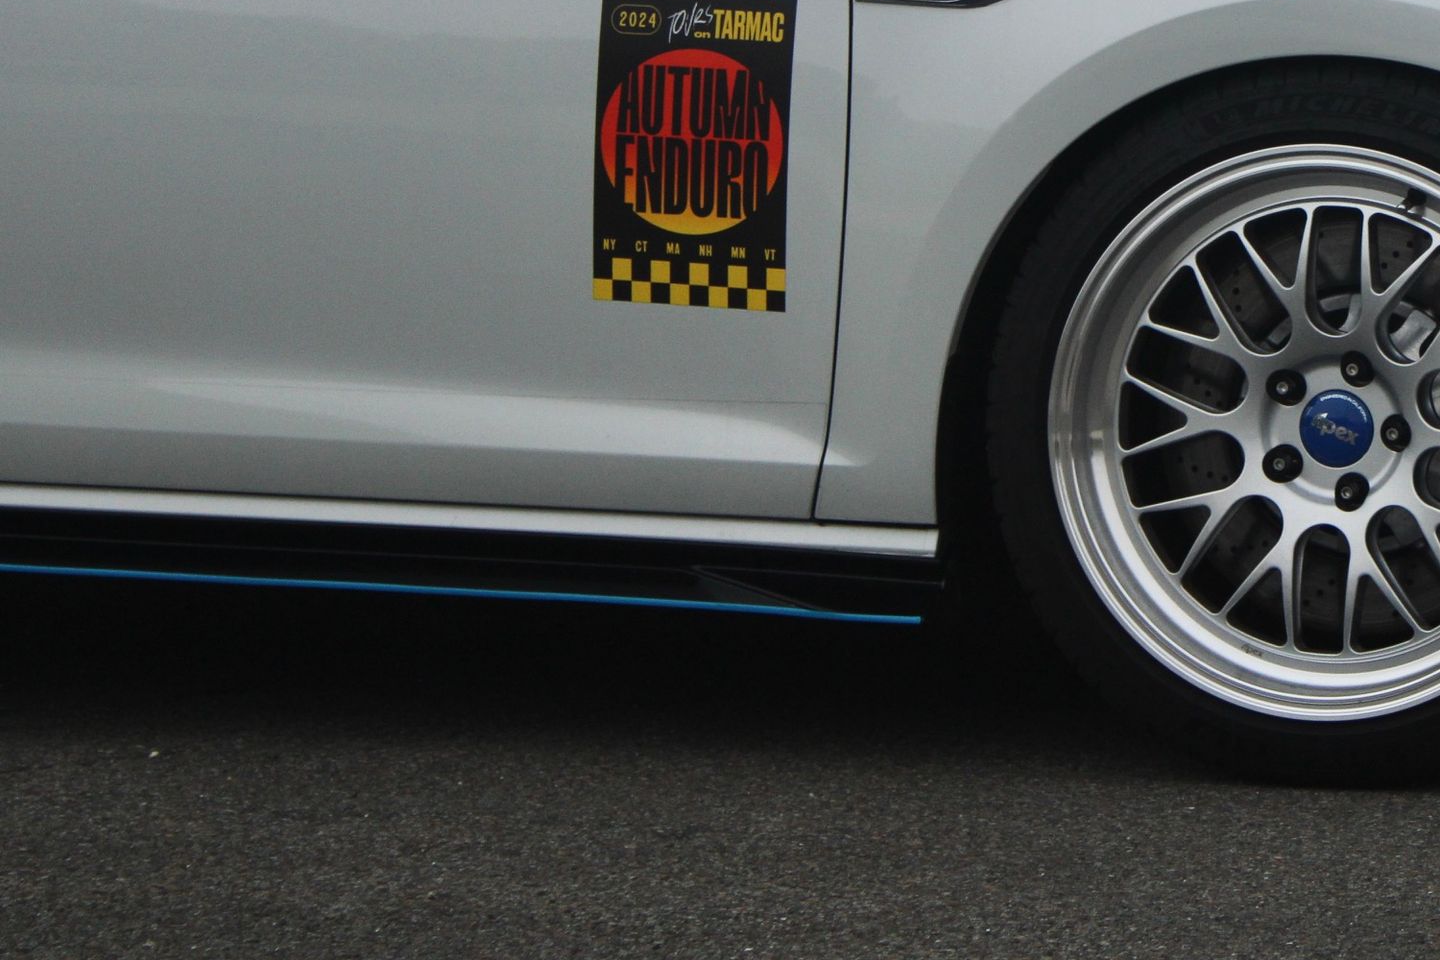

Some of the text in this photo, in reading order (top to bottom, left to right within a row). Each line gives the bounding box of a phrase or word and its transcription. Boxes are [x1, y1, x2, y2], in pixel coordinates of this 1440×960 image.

[619, 11, 657, 28] 2024
[713, 9, 785, 42] TARMAC
[616, 65, 771, 141] AUTUMN
[615, 134, 769, 219] ENDURO
[603, 239, 776, 261] NY CT MA NH MN VT
